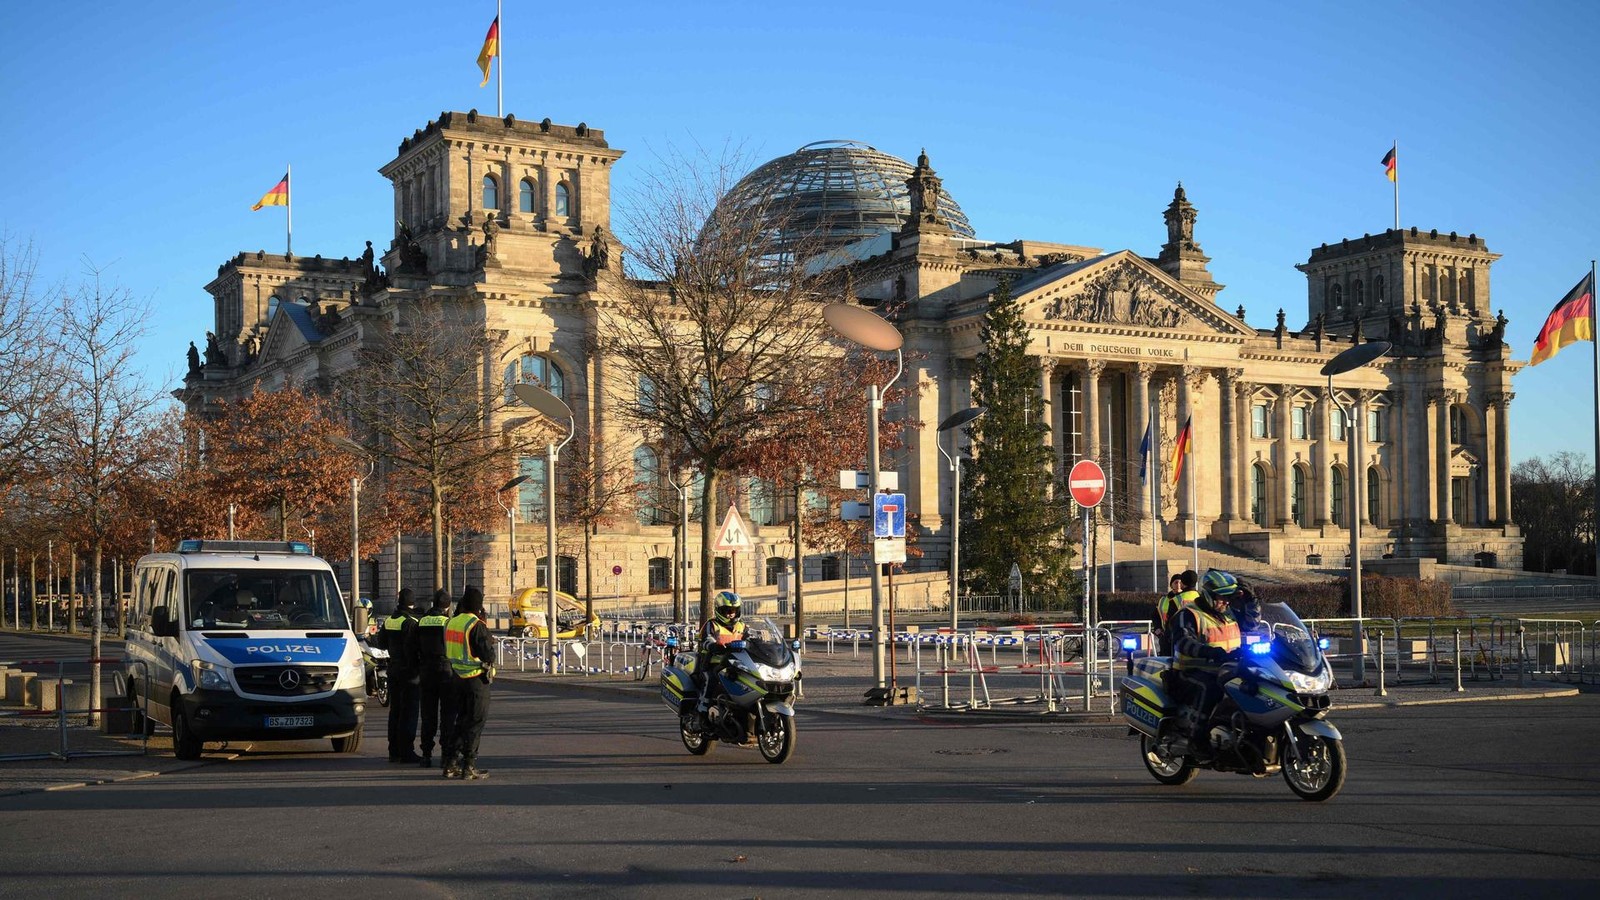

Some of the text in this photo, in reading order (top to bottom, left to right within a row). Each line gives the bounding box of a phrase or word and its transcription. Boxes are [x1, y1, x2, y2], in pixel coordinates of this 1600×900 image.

[1063, 342, 1174, 357] DEM DEUTSCHEN VOLKE
[246, 644, 321, 655] POLIZEI
[1126, 701, 1158, 726] POLIZEI
